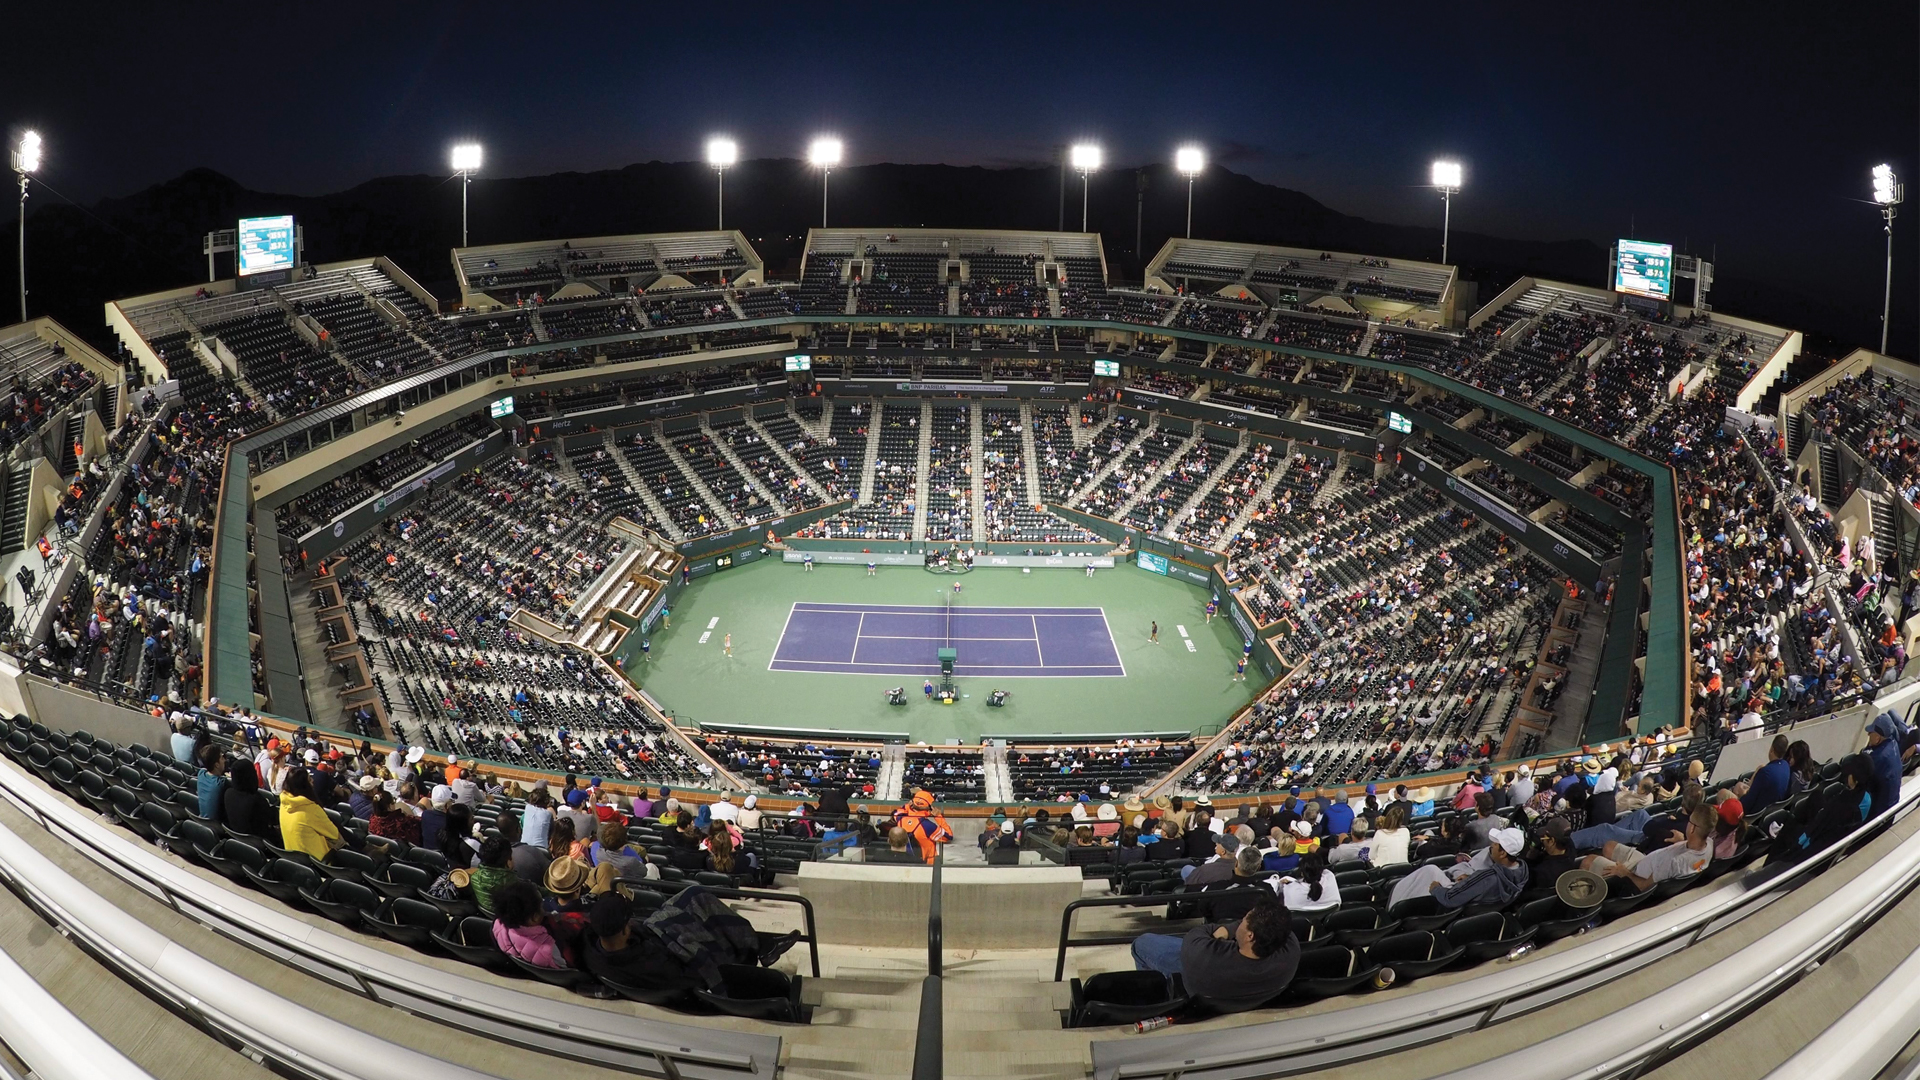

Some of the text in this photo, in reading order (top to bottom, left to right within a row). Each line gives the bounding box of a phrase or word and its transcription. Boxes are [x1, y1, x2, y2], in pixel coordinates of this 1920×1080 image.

[1134, 395, 1158, 404] ORACLE
[552, 420, 572, 428] Hertz
[386, 484, 413, 504] BNP PARIBAS
[1456, 483, 1480, 502] BNP PARIBAS
[710, 532, 734, 541] ORACLE
[1554, 543, 1568, 554] ATP
